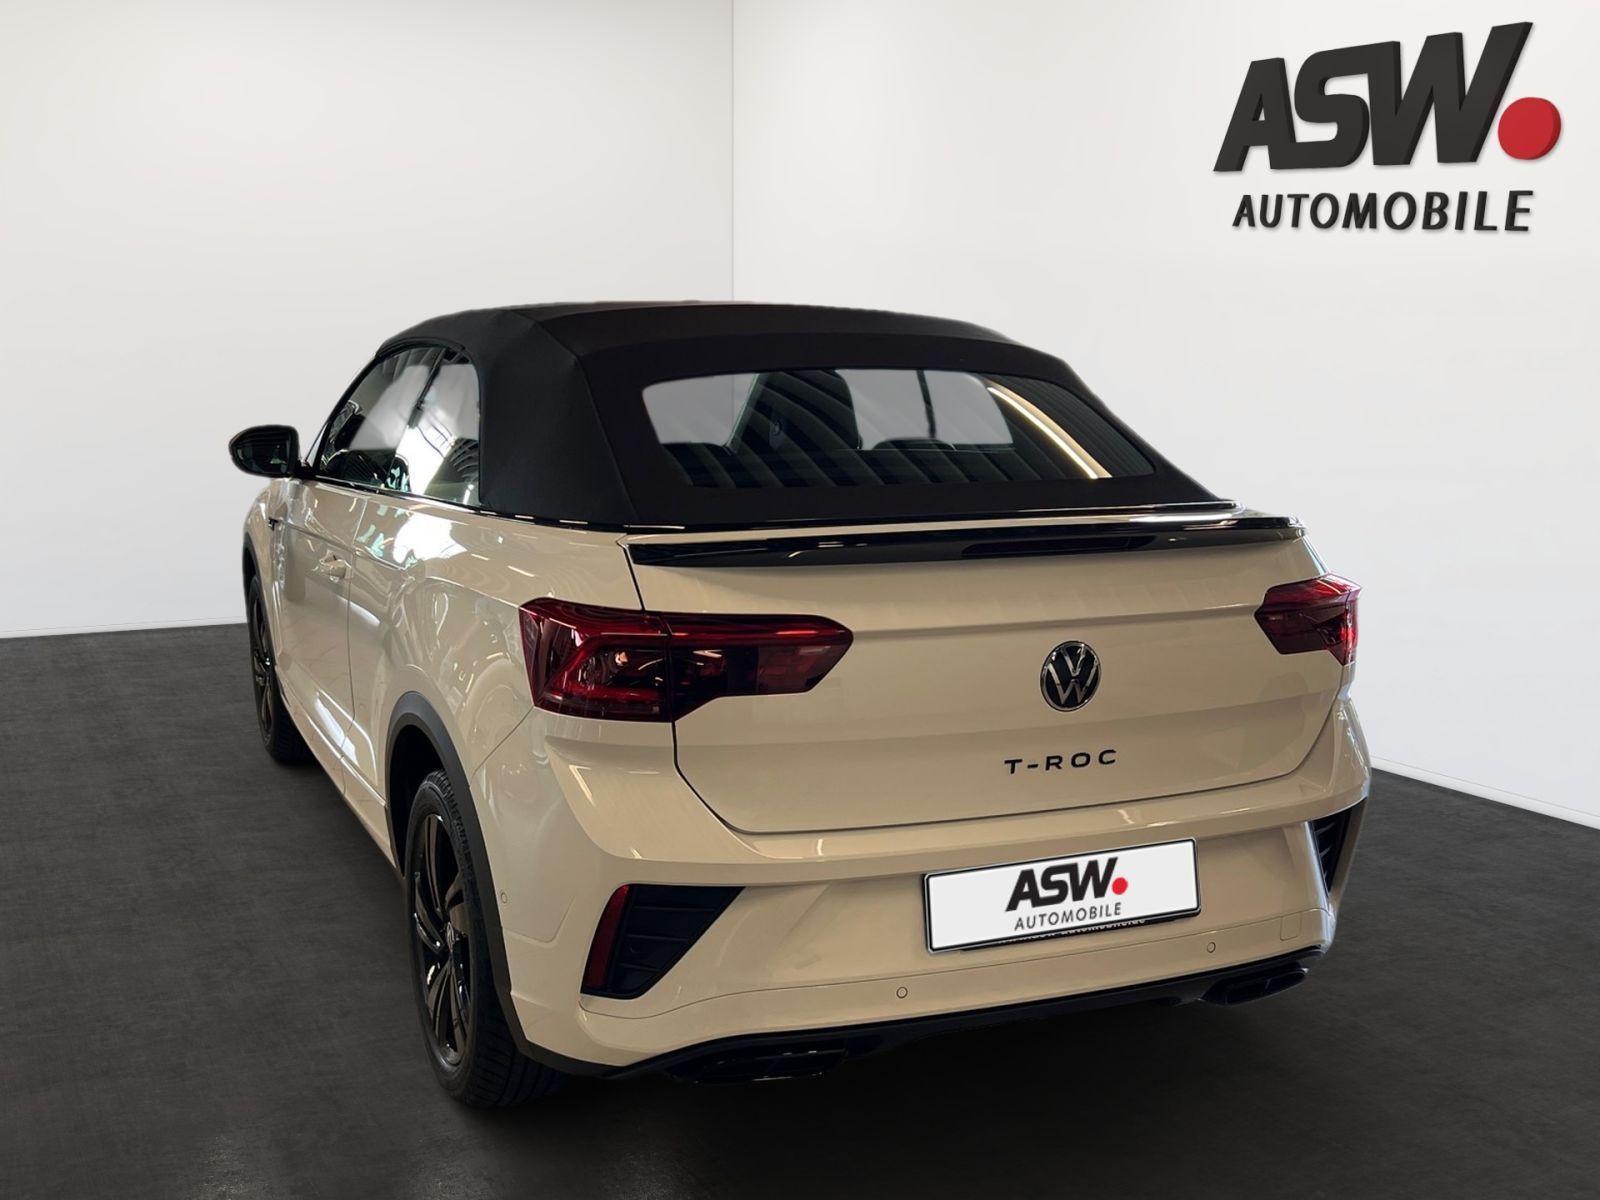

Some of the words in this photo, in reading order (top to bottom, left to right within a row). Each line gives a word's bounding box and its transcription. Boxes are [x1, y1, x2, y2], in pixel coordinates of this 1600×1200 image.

[1232, 190, 1534, 232] AUTOMOBILE
[1041, 642, 1100, 711] VW
[1004, 749, 1117, 775] T-ROC
[1014, 902, 1122, 931] AUTOMOBILE
